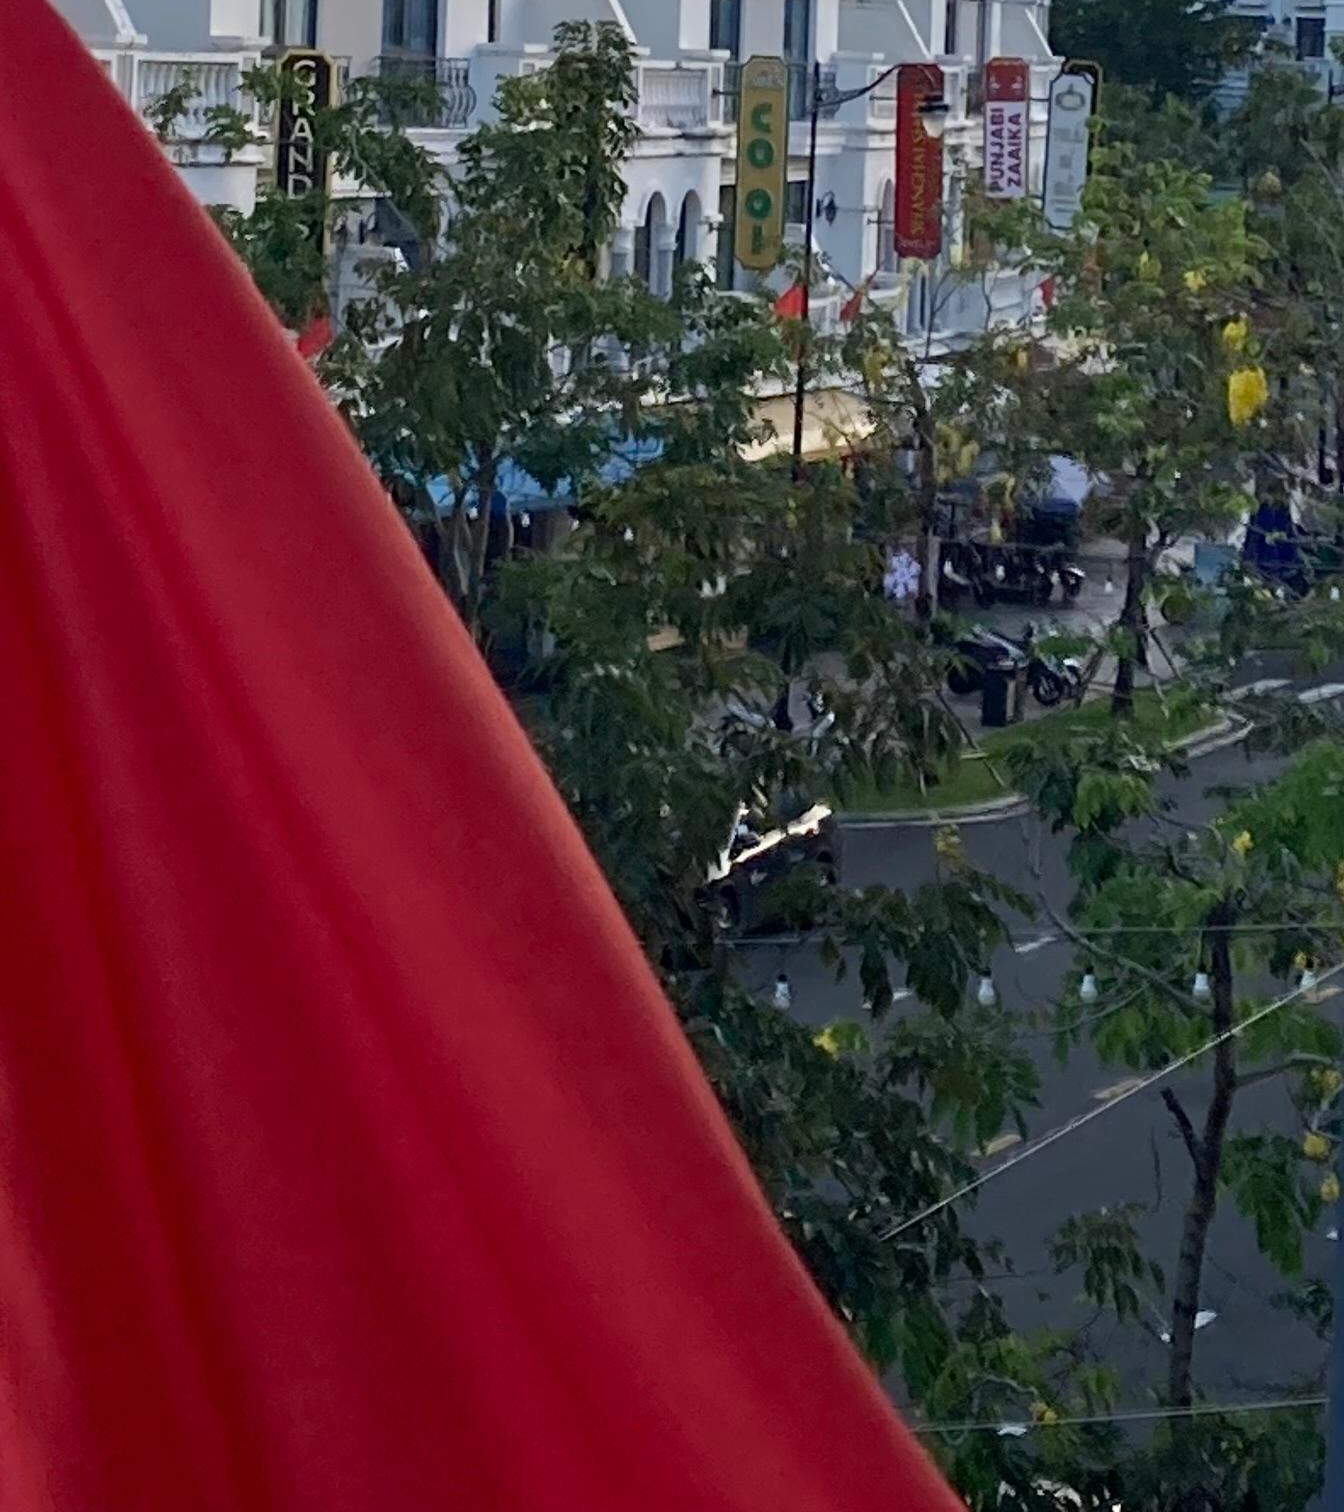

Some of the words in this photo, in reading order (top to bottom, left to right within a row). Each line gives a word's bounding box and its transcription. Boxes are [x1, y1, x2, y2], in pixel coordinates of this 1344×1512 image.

[288, 59, 316, 199] GRAND
[989, 107, 1005, 193] PUNJABI
[1007, 112, 1022, 188] ZAAIKA
